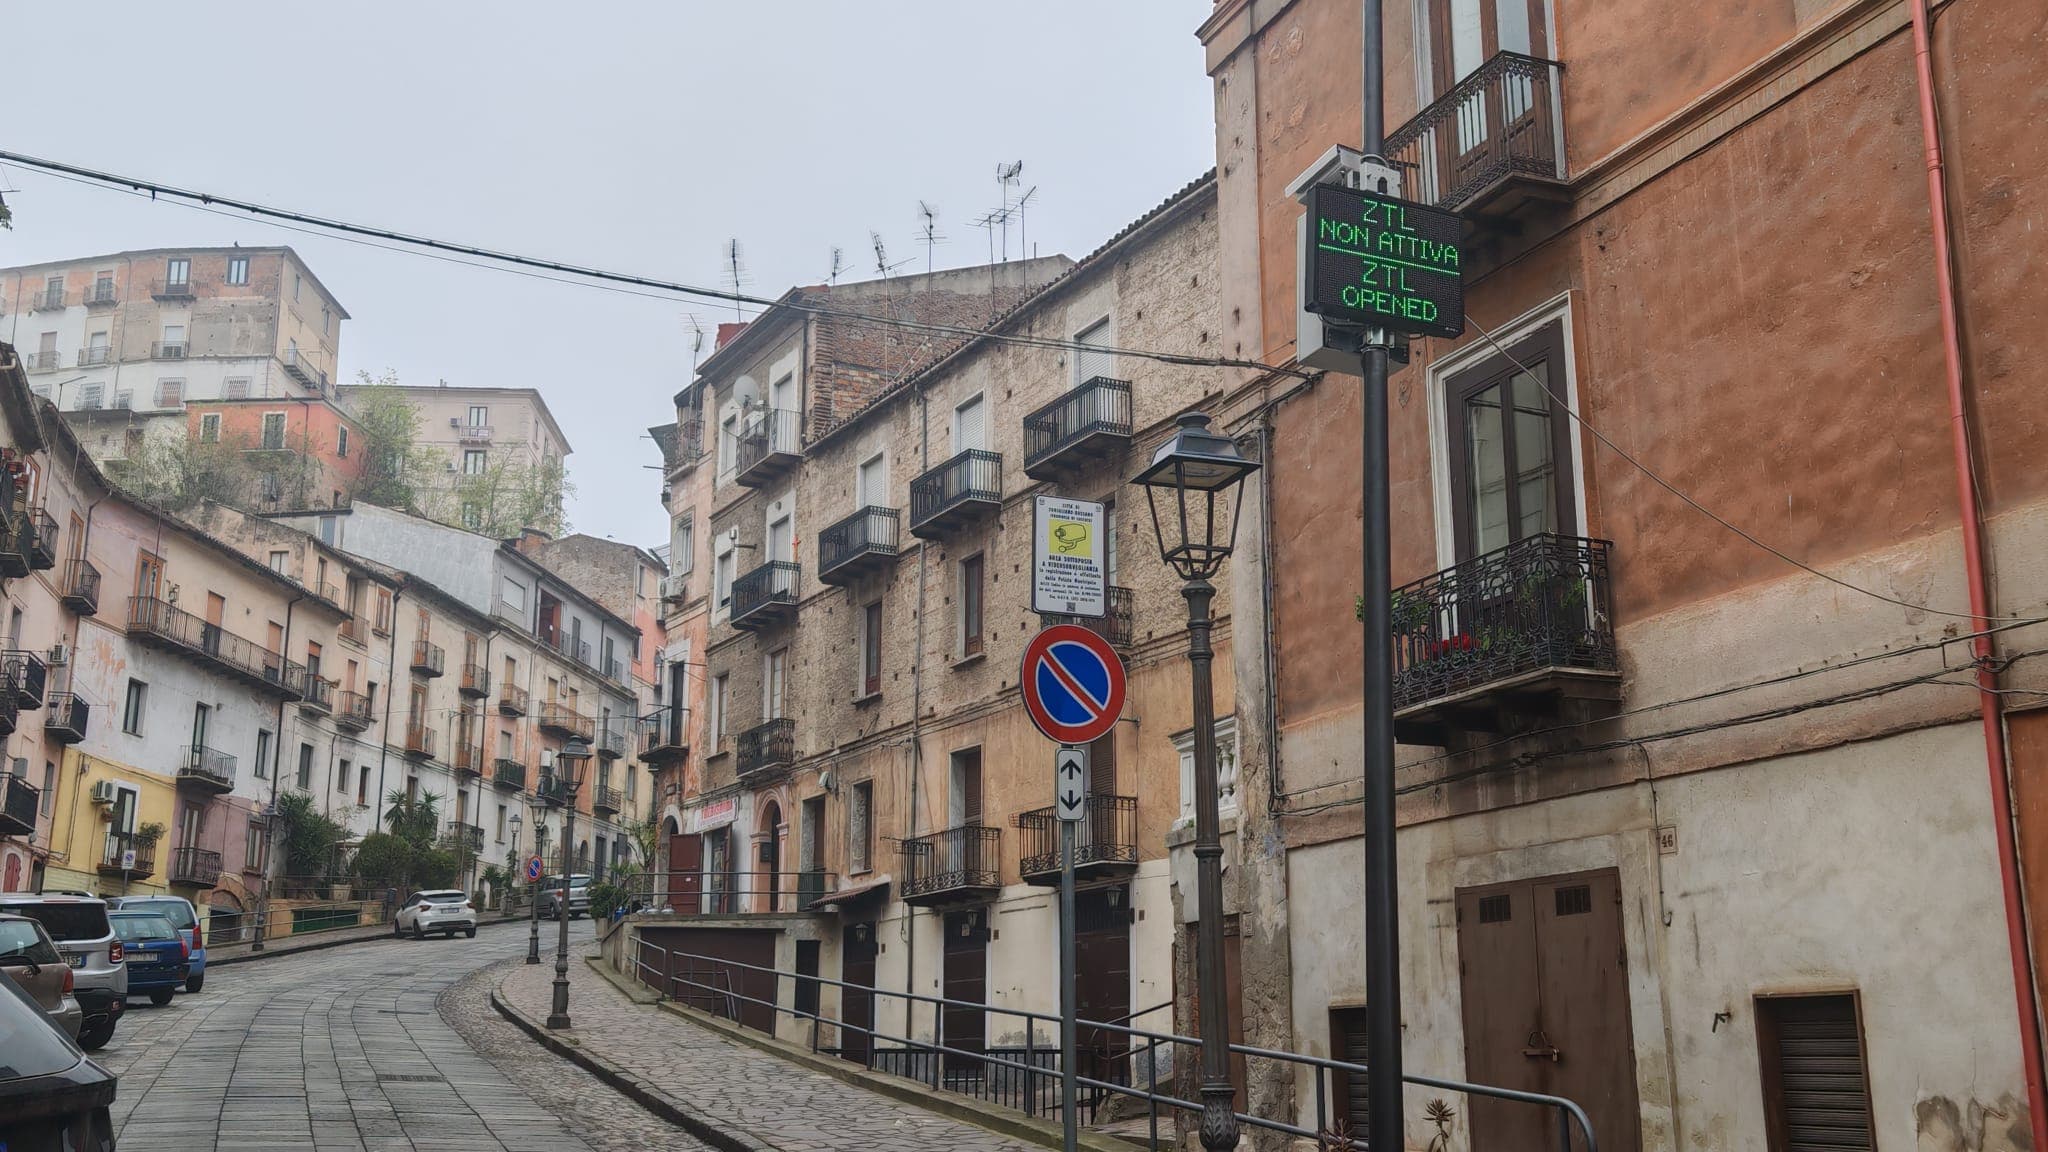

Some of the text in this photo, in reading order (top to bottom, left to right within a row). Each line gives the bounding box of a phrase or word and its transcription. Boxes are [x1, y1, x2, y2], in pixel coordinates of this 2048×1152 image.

[1362, 199, 1415, 231] ZTL
[1320, 218, 1459, 266] NON ATTIVA
[1362, 260, 1415, 292] ZTL
[1341, 285, 1438, 322] OPENED
[1048, 561, 1099, 572] VIDEOSORVEGLIANZA
[1064, 556, 1092, 564] SOTTOPOSTA
[1662, 834, 1673, 848] 46
